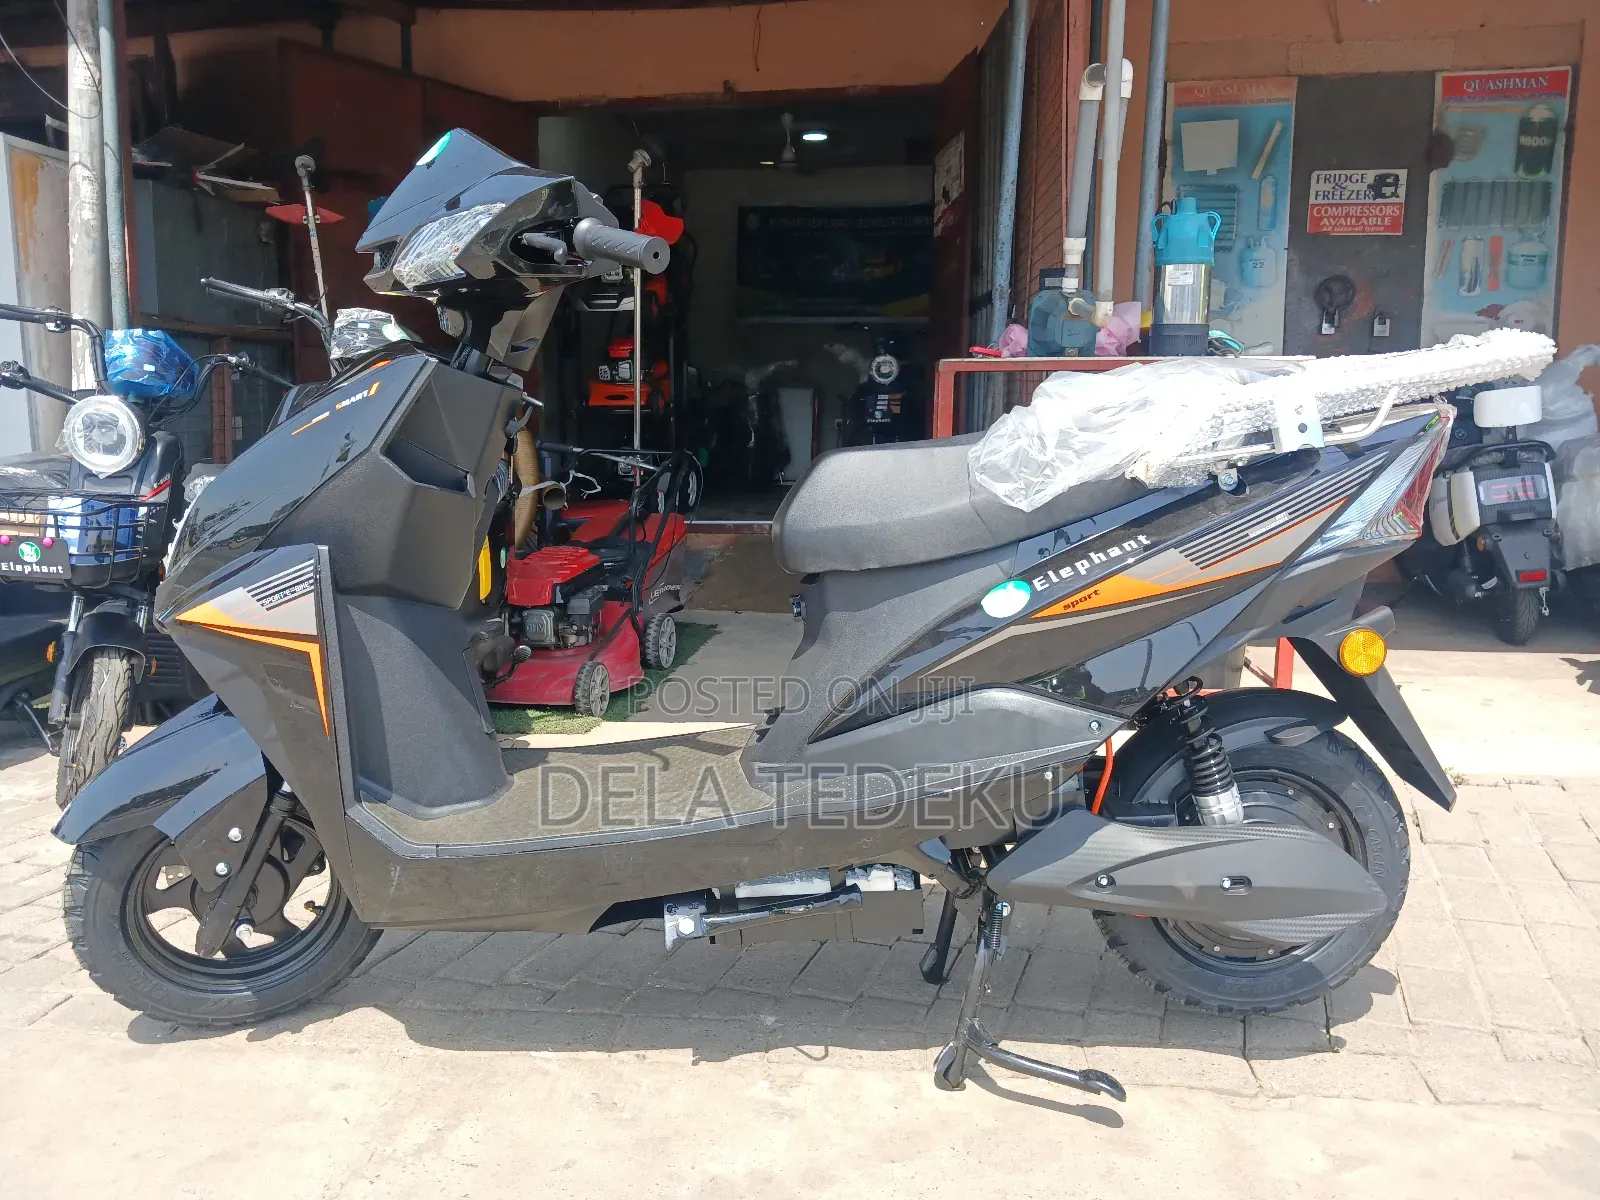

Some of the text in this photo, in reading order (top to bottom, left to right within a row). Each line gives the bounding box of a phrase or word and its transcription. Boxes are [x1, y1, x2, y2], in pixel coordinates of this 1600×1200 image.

[1463, 76, 1550, 92] QUASHMAN
[1316, 173, 1368, 184] FRIDGE
[1332, 182, 1348, 190] &
[1315, 189, 1372, 201] FREEZER
[1313, 205, 1400, 217] COMPRESSORS
[1320, 216, 1392, 226] AVAILABLE
[1252, 261, 1265, 269] 22
[0, 561, 64, 575] Elephant
[1032, 534, 1151, 592] Elephant
[1062, 589, 1101, 611] sport
